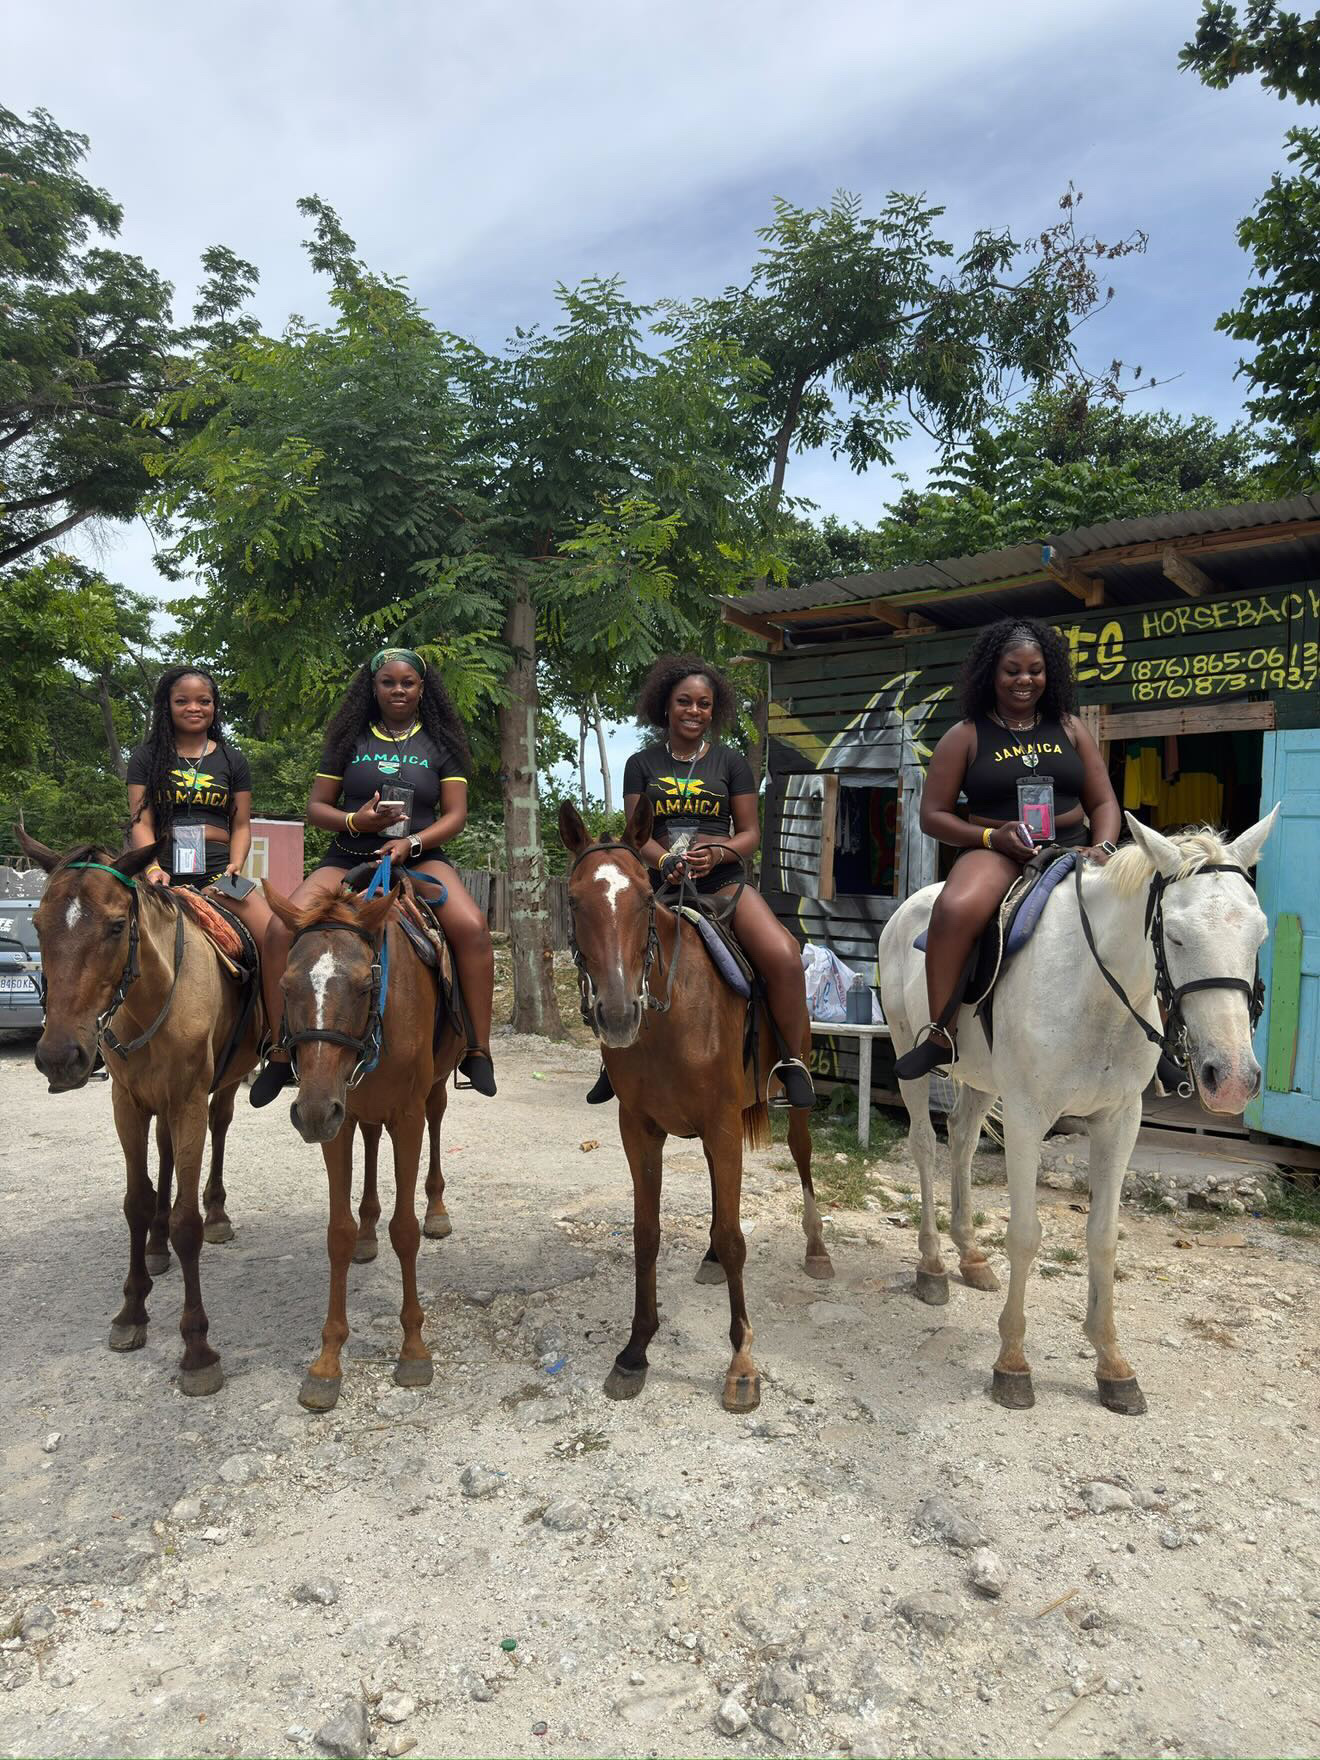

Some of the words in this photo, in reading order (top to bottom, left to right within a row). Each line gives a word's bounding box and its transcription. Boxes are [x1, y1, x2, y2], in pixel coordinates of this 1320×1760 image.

[995, 743, 1062, 762] JAMAICA
[352, 754, 429, 769] JAMAICA
[656, 799, 720, 816] AMAICA
